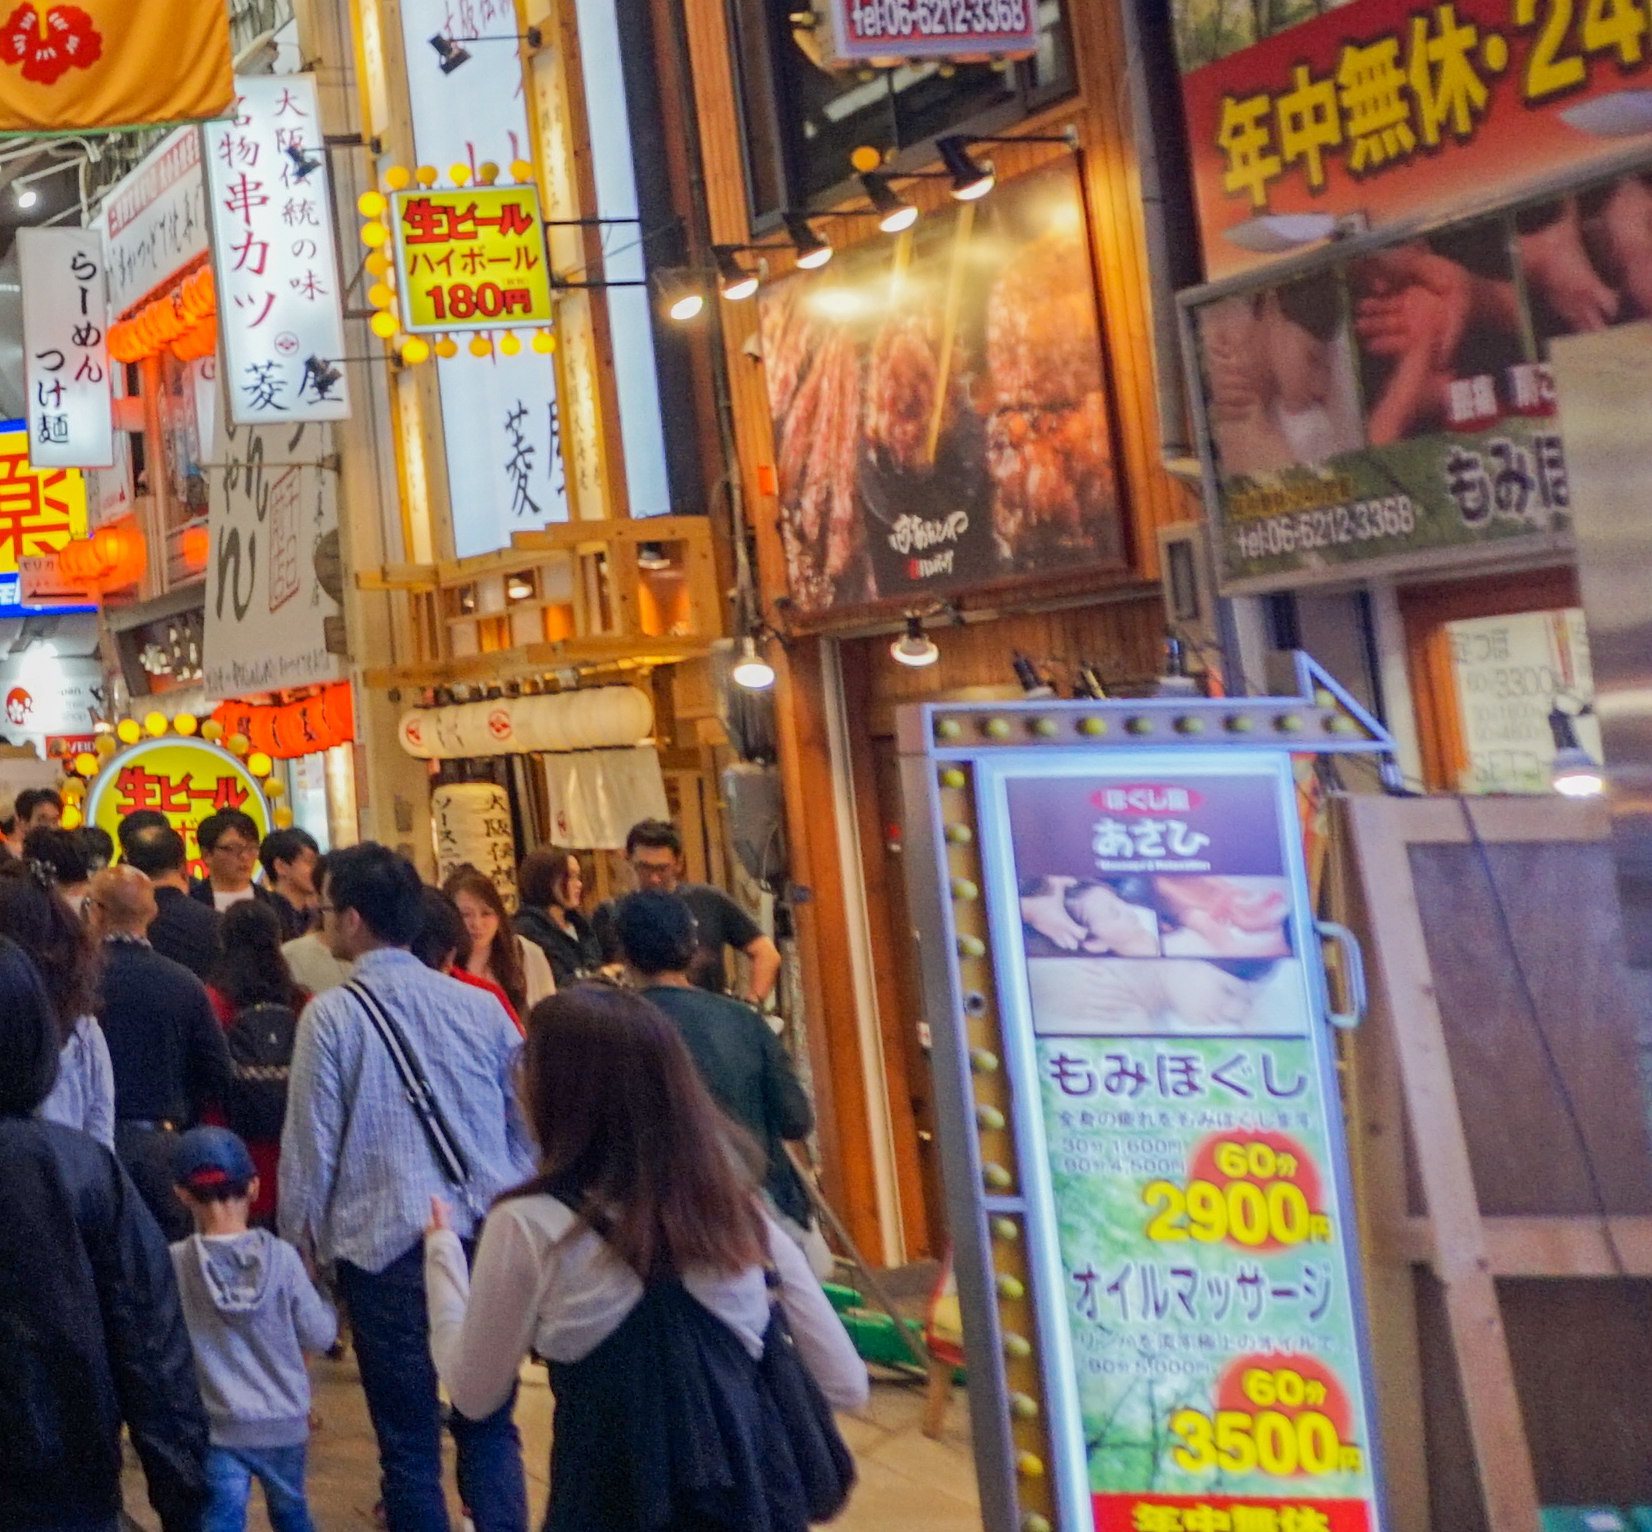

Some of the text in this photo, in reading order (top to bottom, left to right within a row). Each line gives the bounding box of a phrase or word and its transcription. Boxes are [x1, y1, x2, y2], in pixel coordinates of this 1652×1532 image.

[403, 197, 533, 246] 生ビール
[409, 245, 540, 277] ハイボール
[70, 251, 103, 384] らーめん
[426, 281, 533, 320] 180円
[35, 349, 70, 445] つけ麺
[115, 766, 250, 816] 生ビール
[1092, 818, 1211, 859] あさひ
[1049, 1051, 1309, 1101] もみほぐし
[1213, 1140, 1299, 1180] 60分
[1141, 1178, 1333, 1247] 2900円
[1072, 1263, 1332, 1322] オイルマッサージ
[1242, 1367, 1327, 1407] 60分
[1169, 1406, 1363, 1476] 3500円
